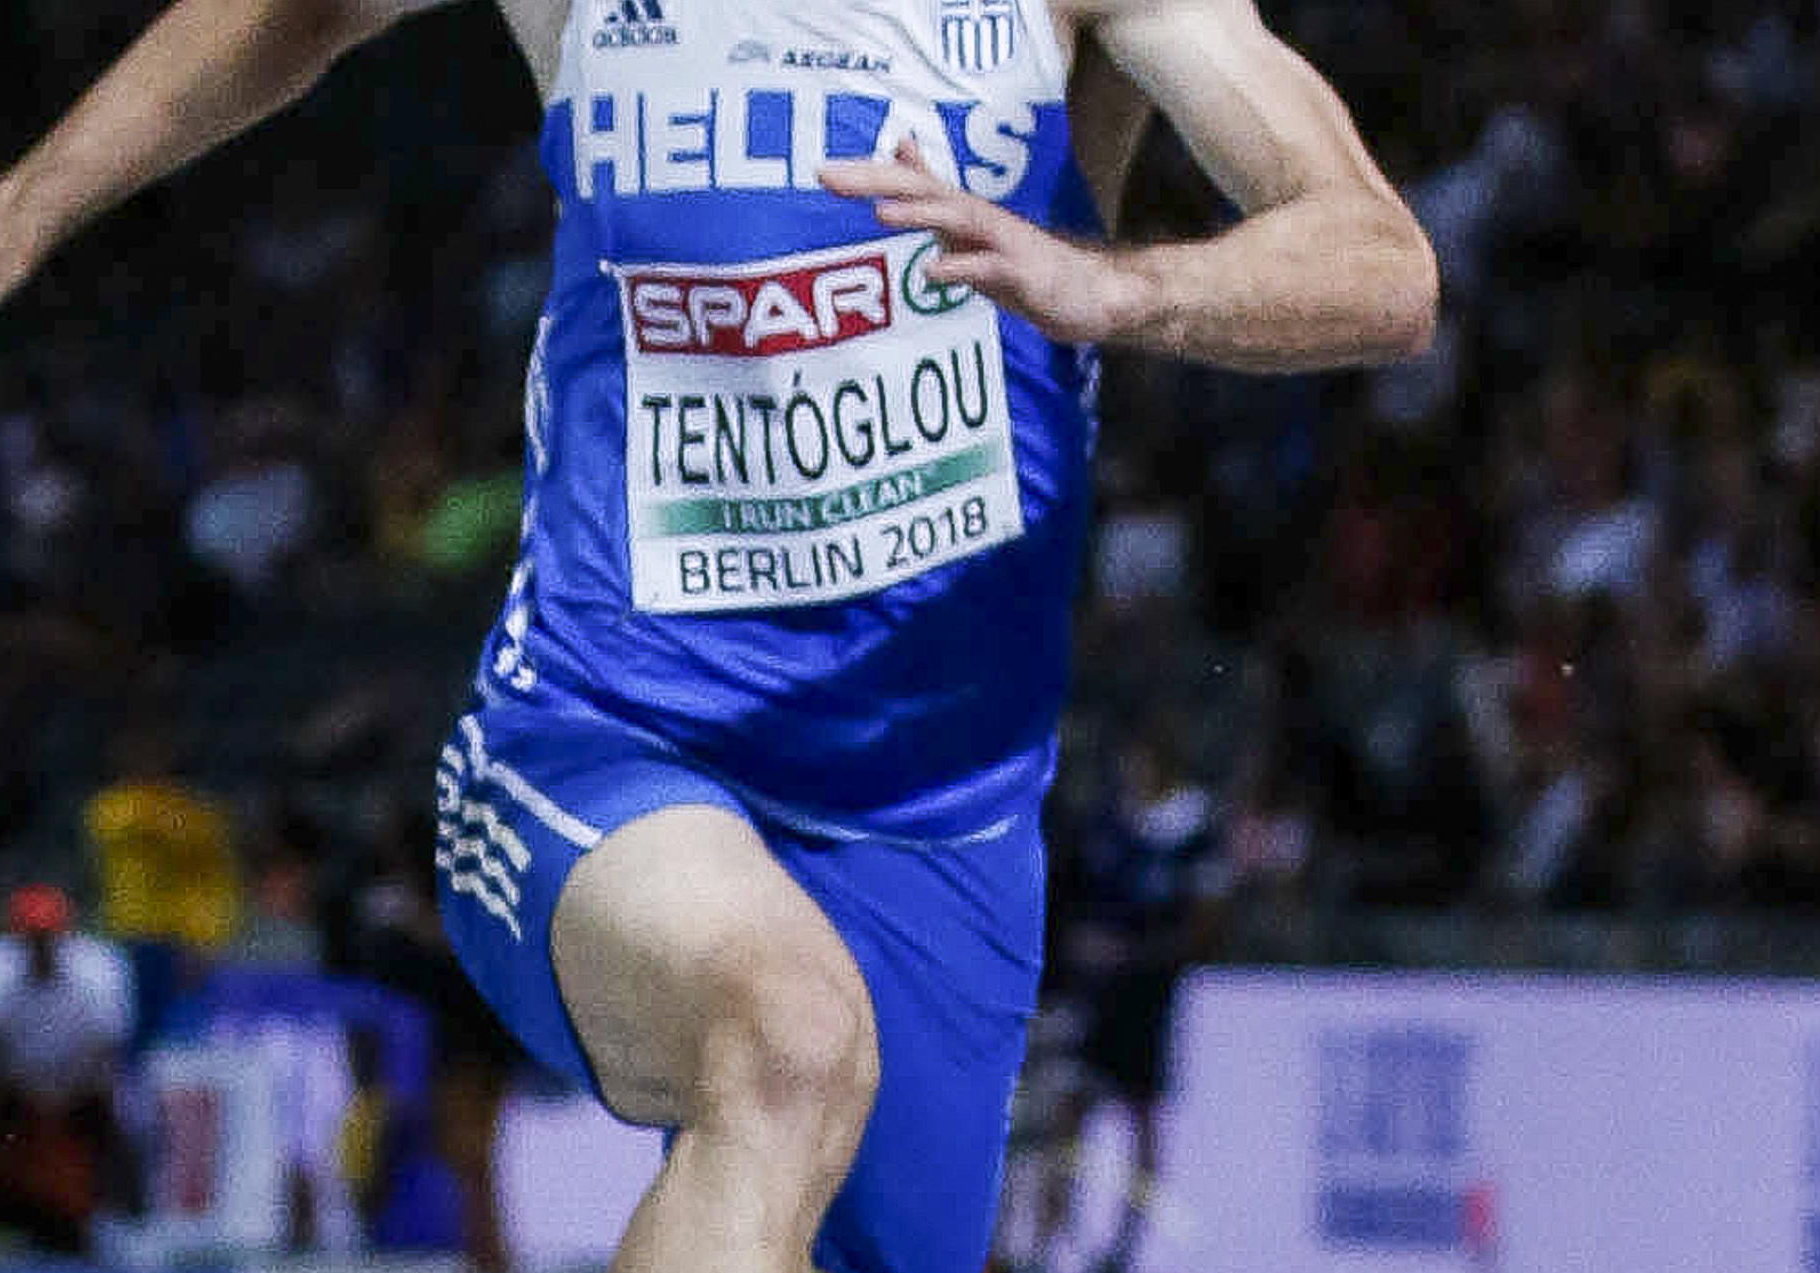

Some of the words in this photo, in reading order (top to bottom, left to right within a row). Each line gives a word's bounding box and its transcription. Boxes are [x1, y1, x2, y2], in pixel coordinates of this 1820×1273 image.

[592, 26, 679, 50] adidas
[782, 48, 891, 75] AEGEAN
[569, 88, 1039, 202] HELLAS
[632, 263, 887, 350] SPAR
[641, 340, 989, 487] TENTÓGLOU
[679, 534, 865, 596] BERLIN
[882, 494, 988, 569] 2018
